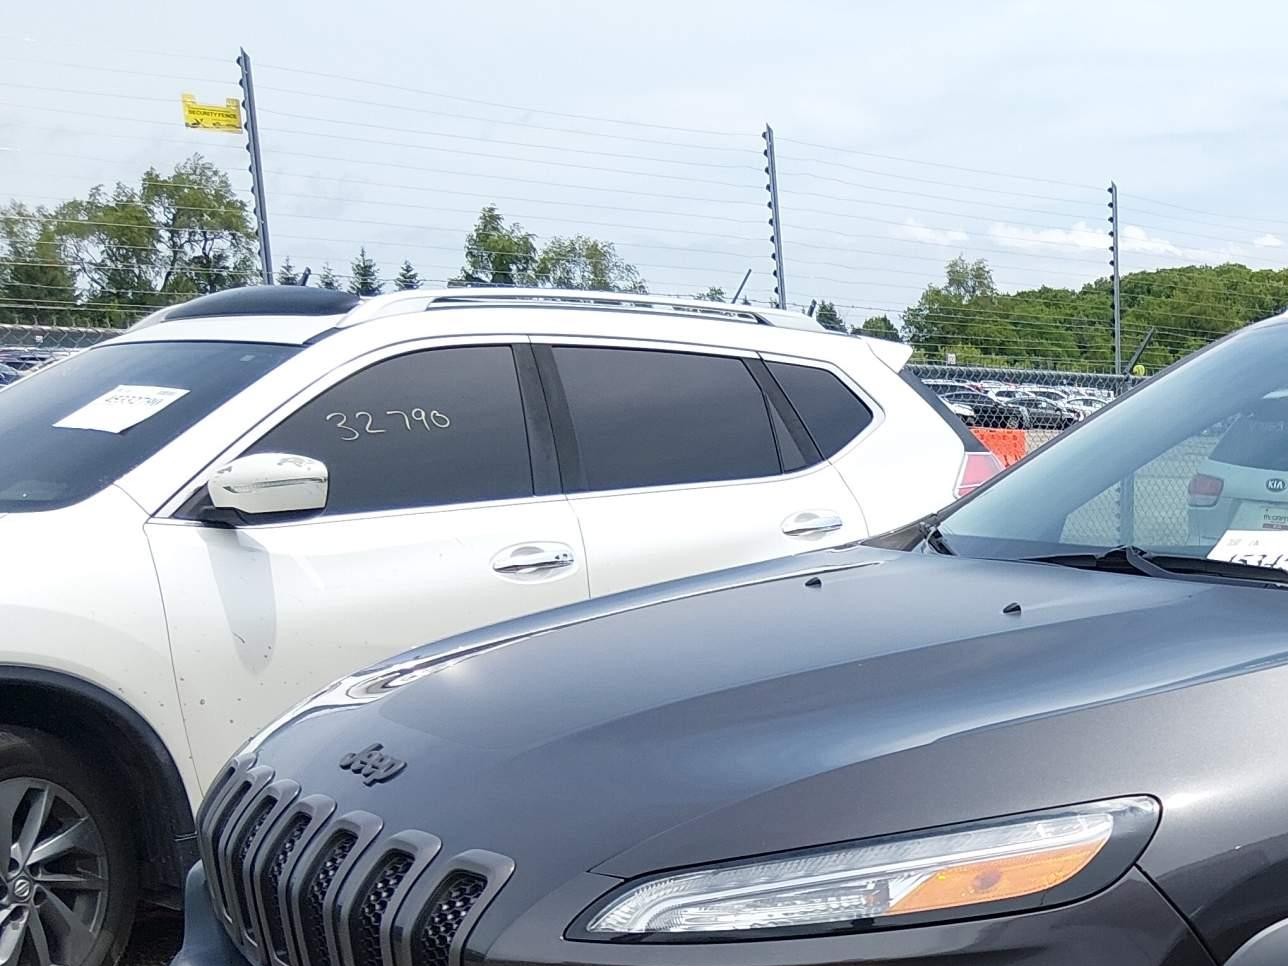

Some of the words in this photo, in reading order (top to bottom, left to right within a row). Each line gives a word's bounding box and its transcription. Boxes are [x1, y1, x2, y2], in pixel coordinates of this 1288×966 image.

[325, 408, 451, 441] 32790
[1267, 479, 1284, 489] KIA
[338, 742, 408, 788] Jeep
